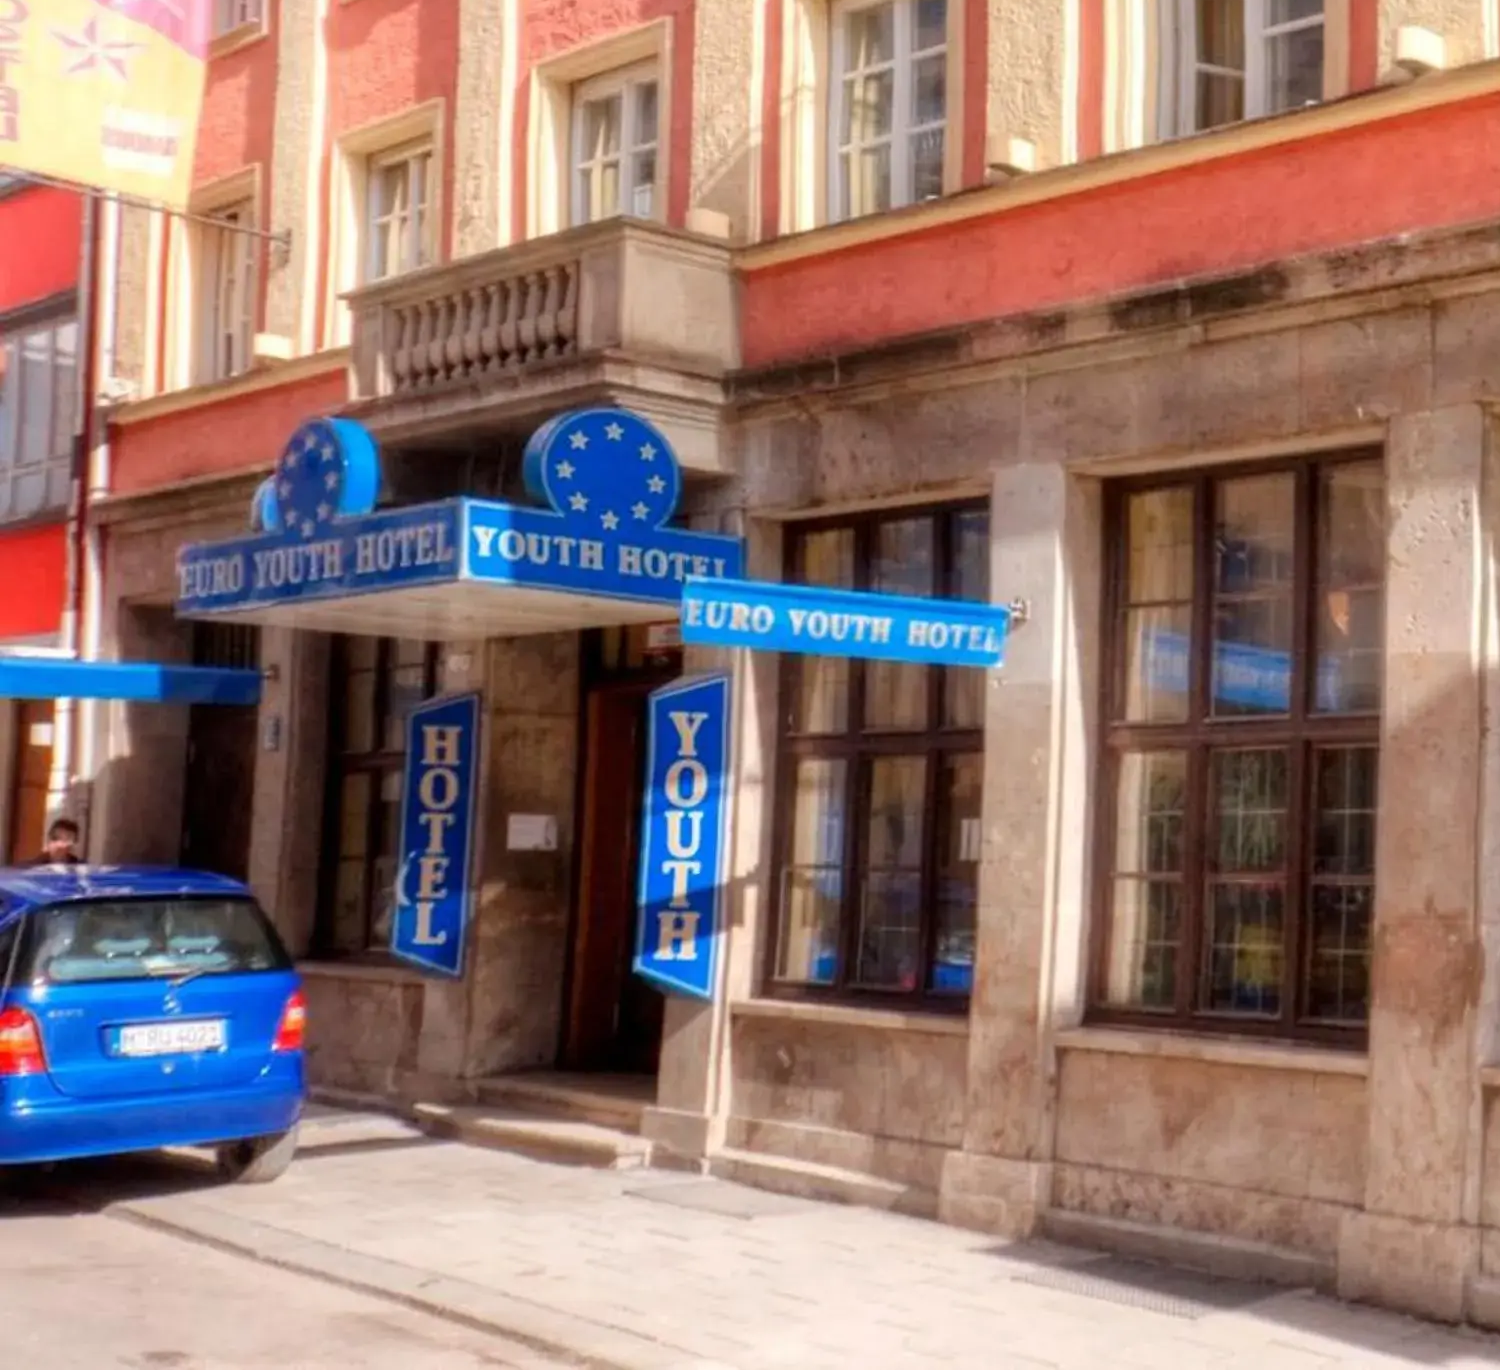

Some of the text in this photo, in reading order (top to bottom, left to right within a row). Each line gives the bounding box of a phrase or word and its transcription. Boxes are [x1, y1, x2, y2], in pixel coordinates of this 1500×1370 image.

[177, 522, 453, 600] EURO YOUTH HOTEL
[472, 525, 605, 571] YOUTH
[684, 598, 1000, 654] EURO YOUTH HOTEL
[412, 725, 463, 945] HOTEL
[653, 710, 709, 961] YOUTH
